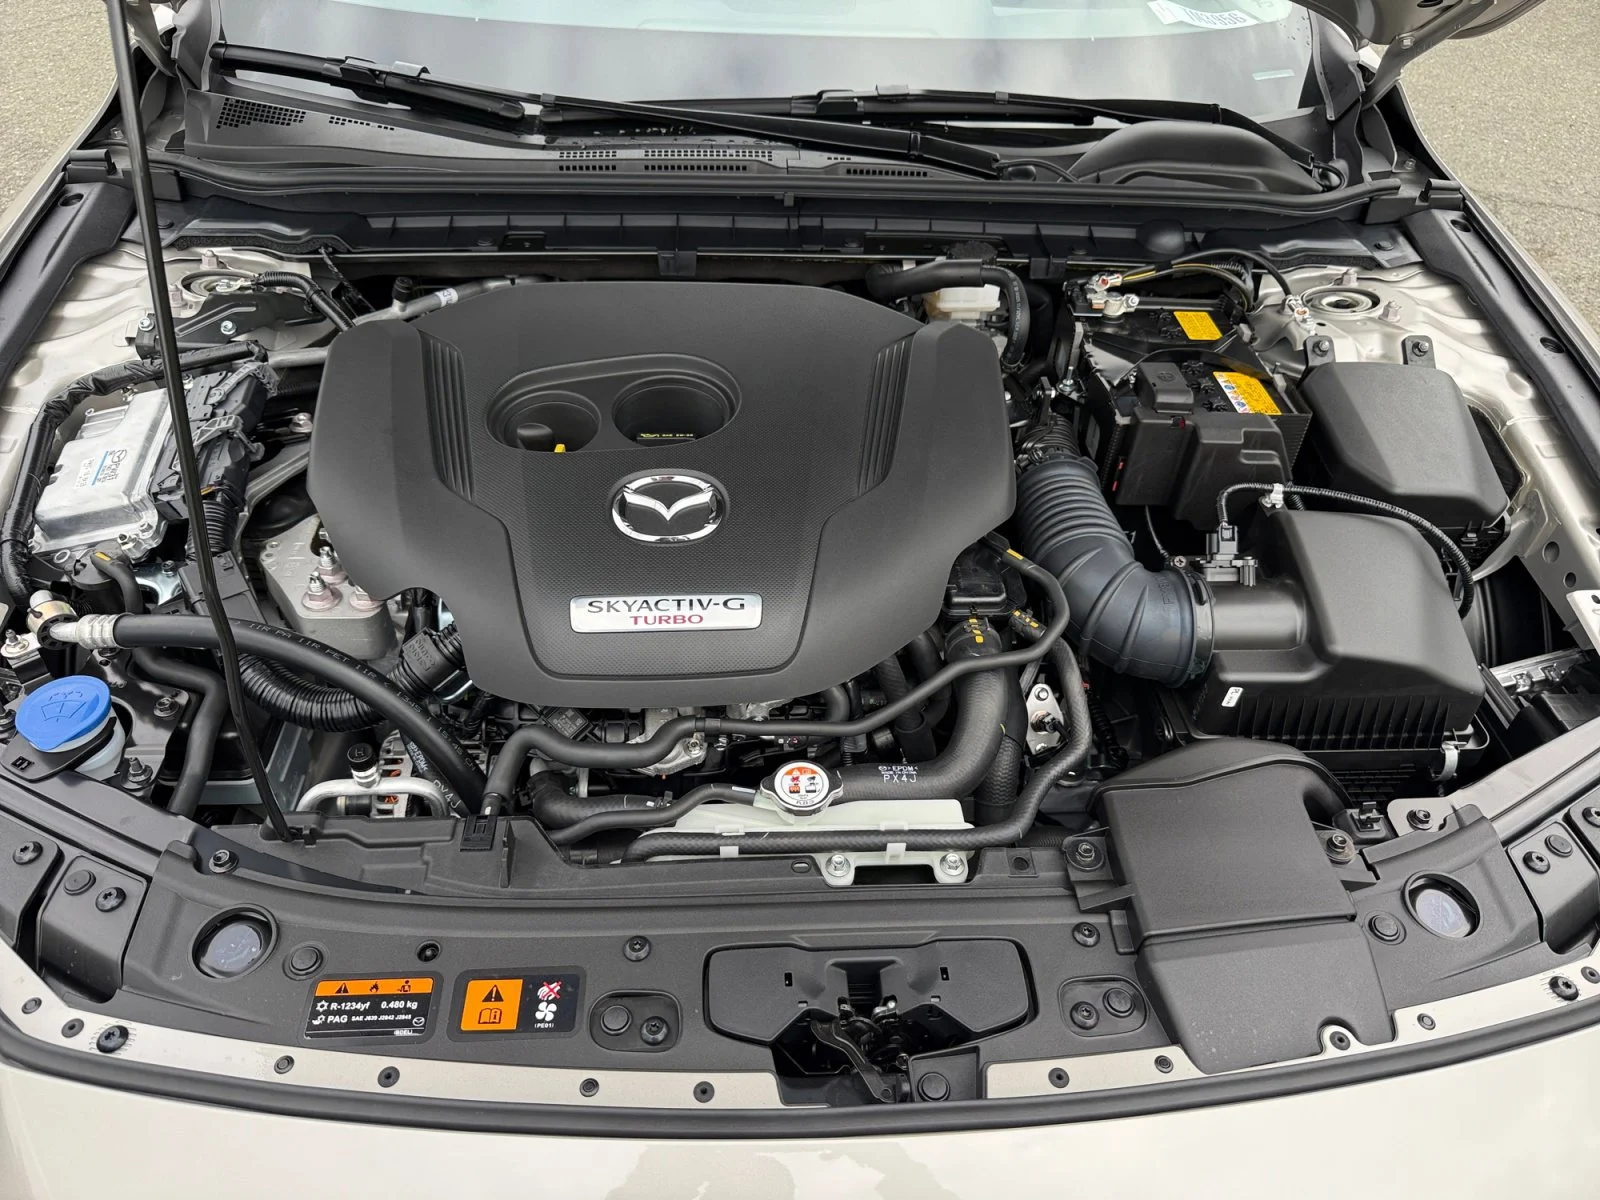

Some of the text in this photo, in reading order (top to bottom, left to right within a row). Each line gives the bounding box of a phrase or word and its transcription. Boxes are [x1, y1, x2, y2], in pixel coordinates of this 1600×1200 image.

[587, 597, 745, 613] SKYACTIV-G
[629, 614, 704, 626] TURBO
[883, 774, 917, 783] PX4J
[330, 1001, 418, 1011] R-1234yf 0.480 kg
[327, 1015, 348, 1023] PAG
